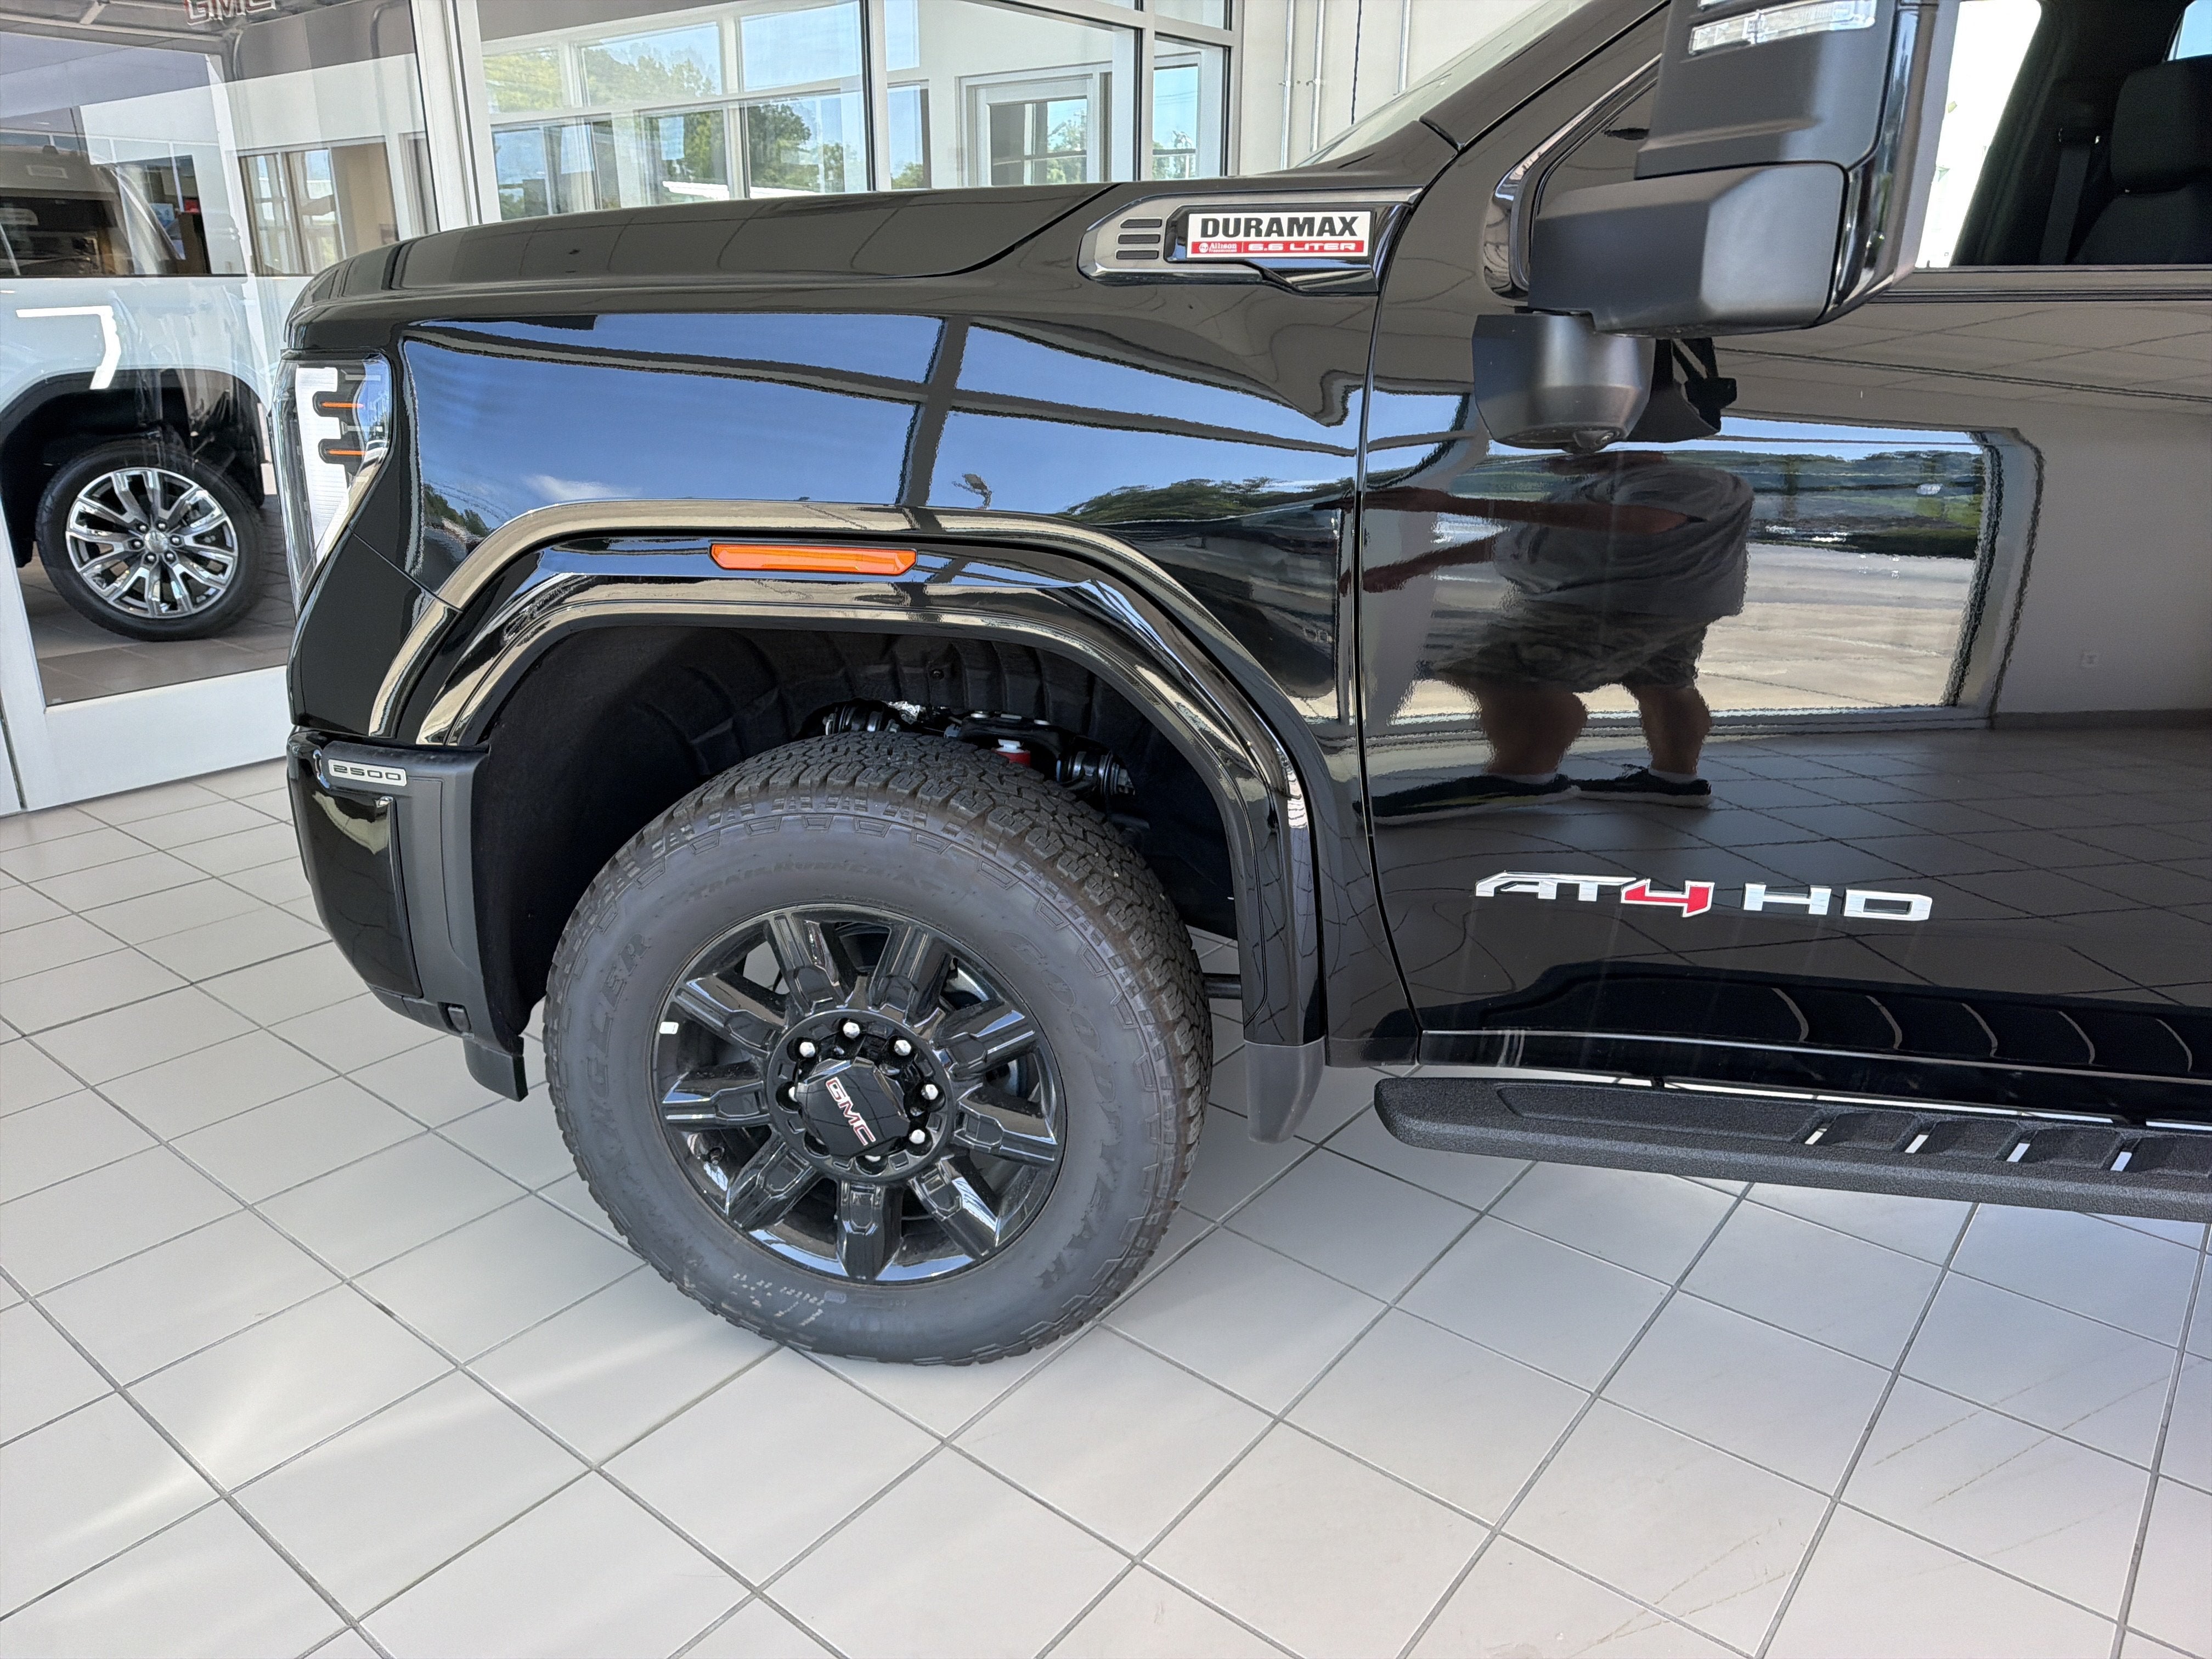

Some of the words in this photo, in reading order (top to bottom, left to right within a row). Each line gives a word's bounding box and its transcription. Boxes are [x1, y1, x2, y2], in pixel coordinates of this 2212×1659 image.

[1200, 216, 1359, 238] DURAMAX
[1248, 243, 1284, 251] 6.6
[1289, 242, 1357, 251] LITER
[333, 764, 401, 781] 2500
[1476, 870, 1716, 918] AT4
[1741, 882, 1933, 921] HD
[825, 1076, 877, 1147] GMC
[1003, 932, 1122, 1289] GOODYEAR
